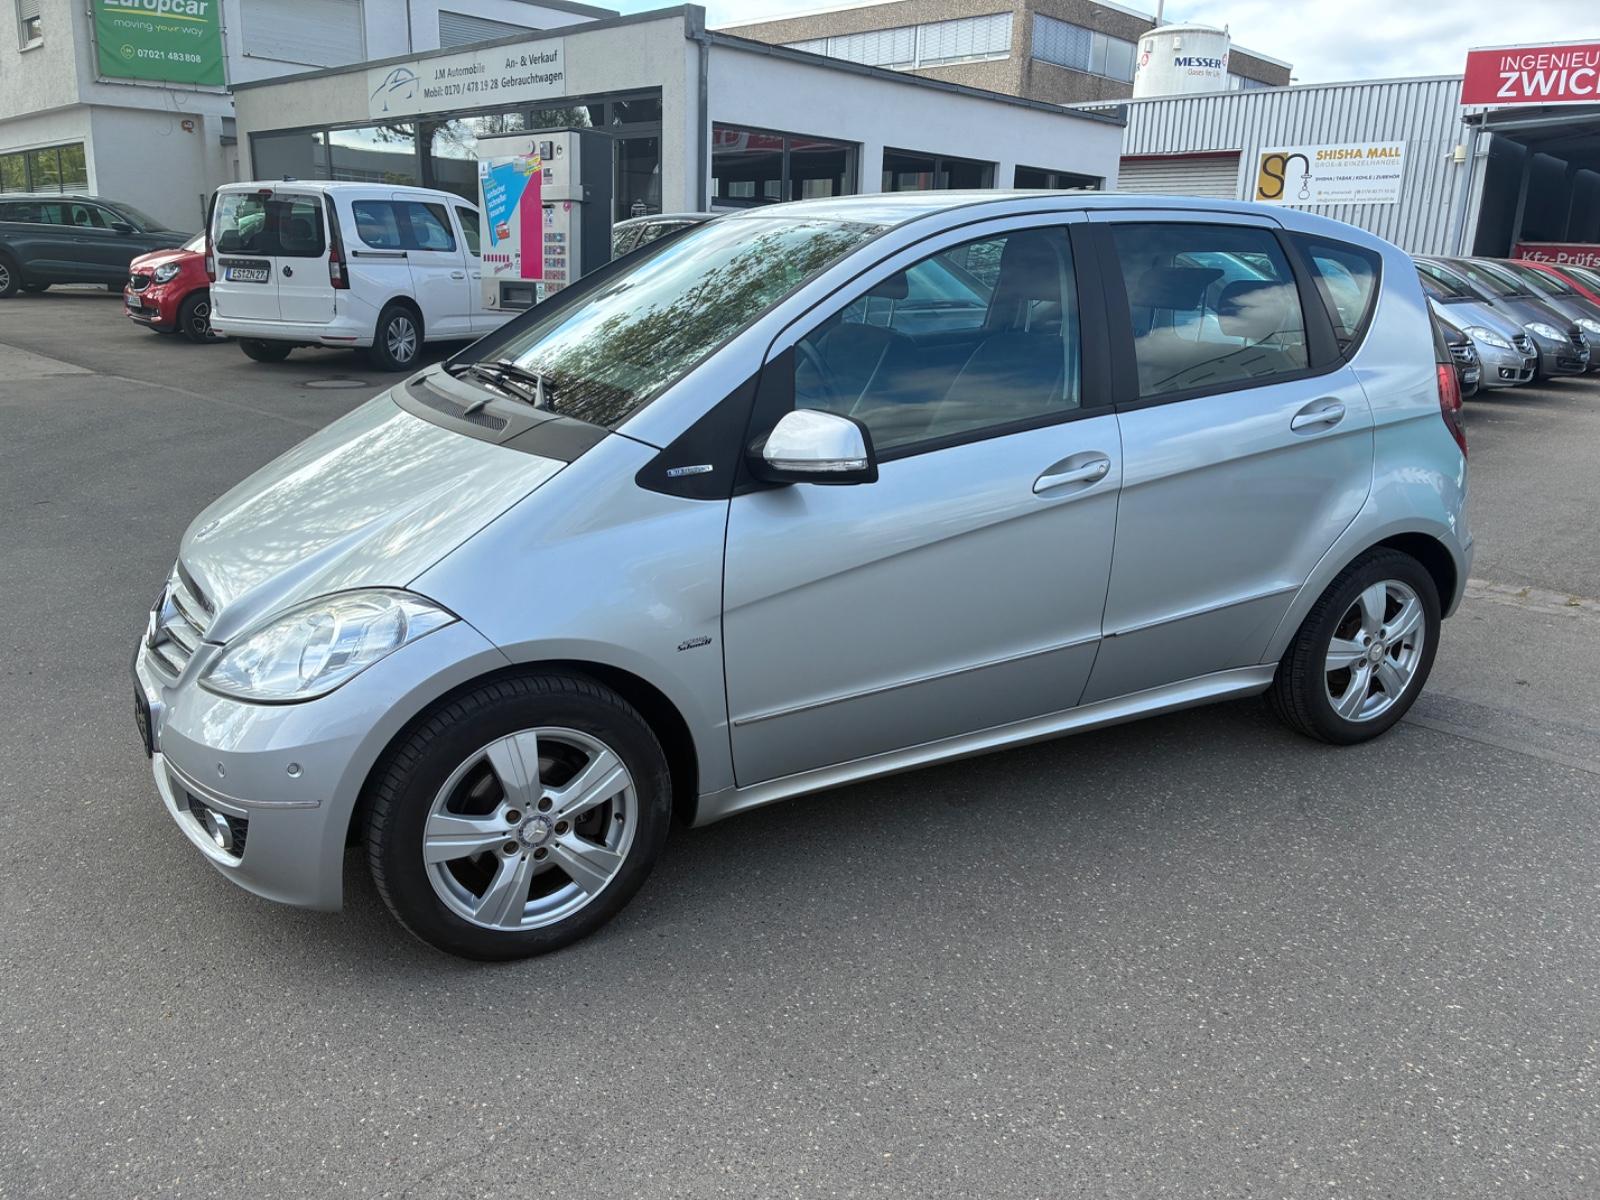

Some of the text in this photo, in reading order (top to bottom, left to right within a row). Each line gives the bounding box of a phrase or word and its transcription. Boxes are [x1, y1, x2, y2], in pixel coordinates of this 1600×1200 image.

[113, 19, 203, 37] moving your way
[137, 49, 165, 59] 07021
[528, 50, 558, 65] Verkauf
[1174, 56, 1221, 69] MESSER
[1500, 51, 1600, 71] INGENIEU
[447, 62, 485, 79] Automobile
[501, 71, 564, 89] Gebrauchtwagen
[1497, 67, 1600, 98] ZWIC
[424, 86, 443, 99] Mobil:
[444, 84, 461, 96] 0170
[467, 81, 479, 93] 478
[480, 80, 488, 92] 19
[1316, 147, 1401, 161] SHISHA MALL
[232, 269, 242, 279] ES
[256, 270, 265, 280] 27
